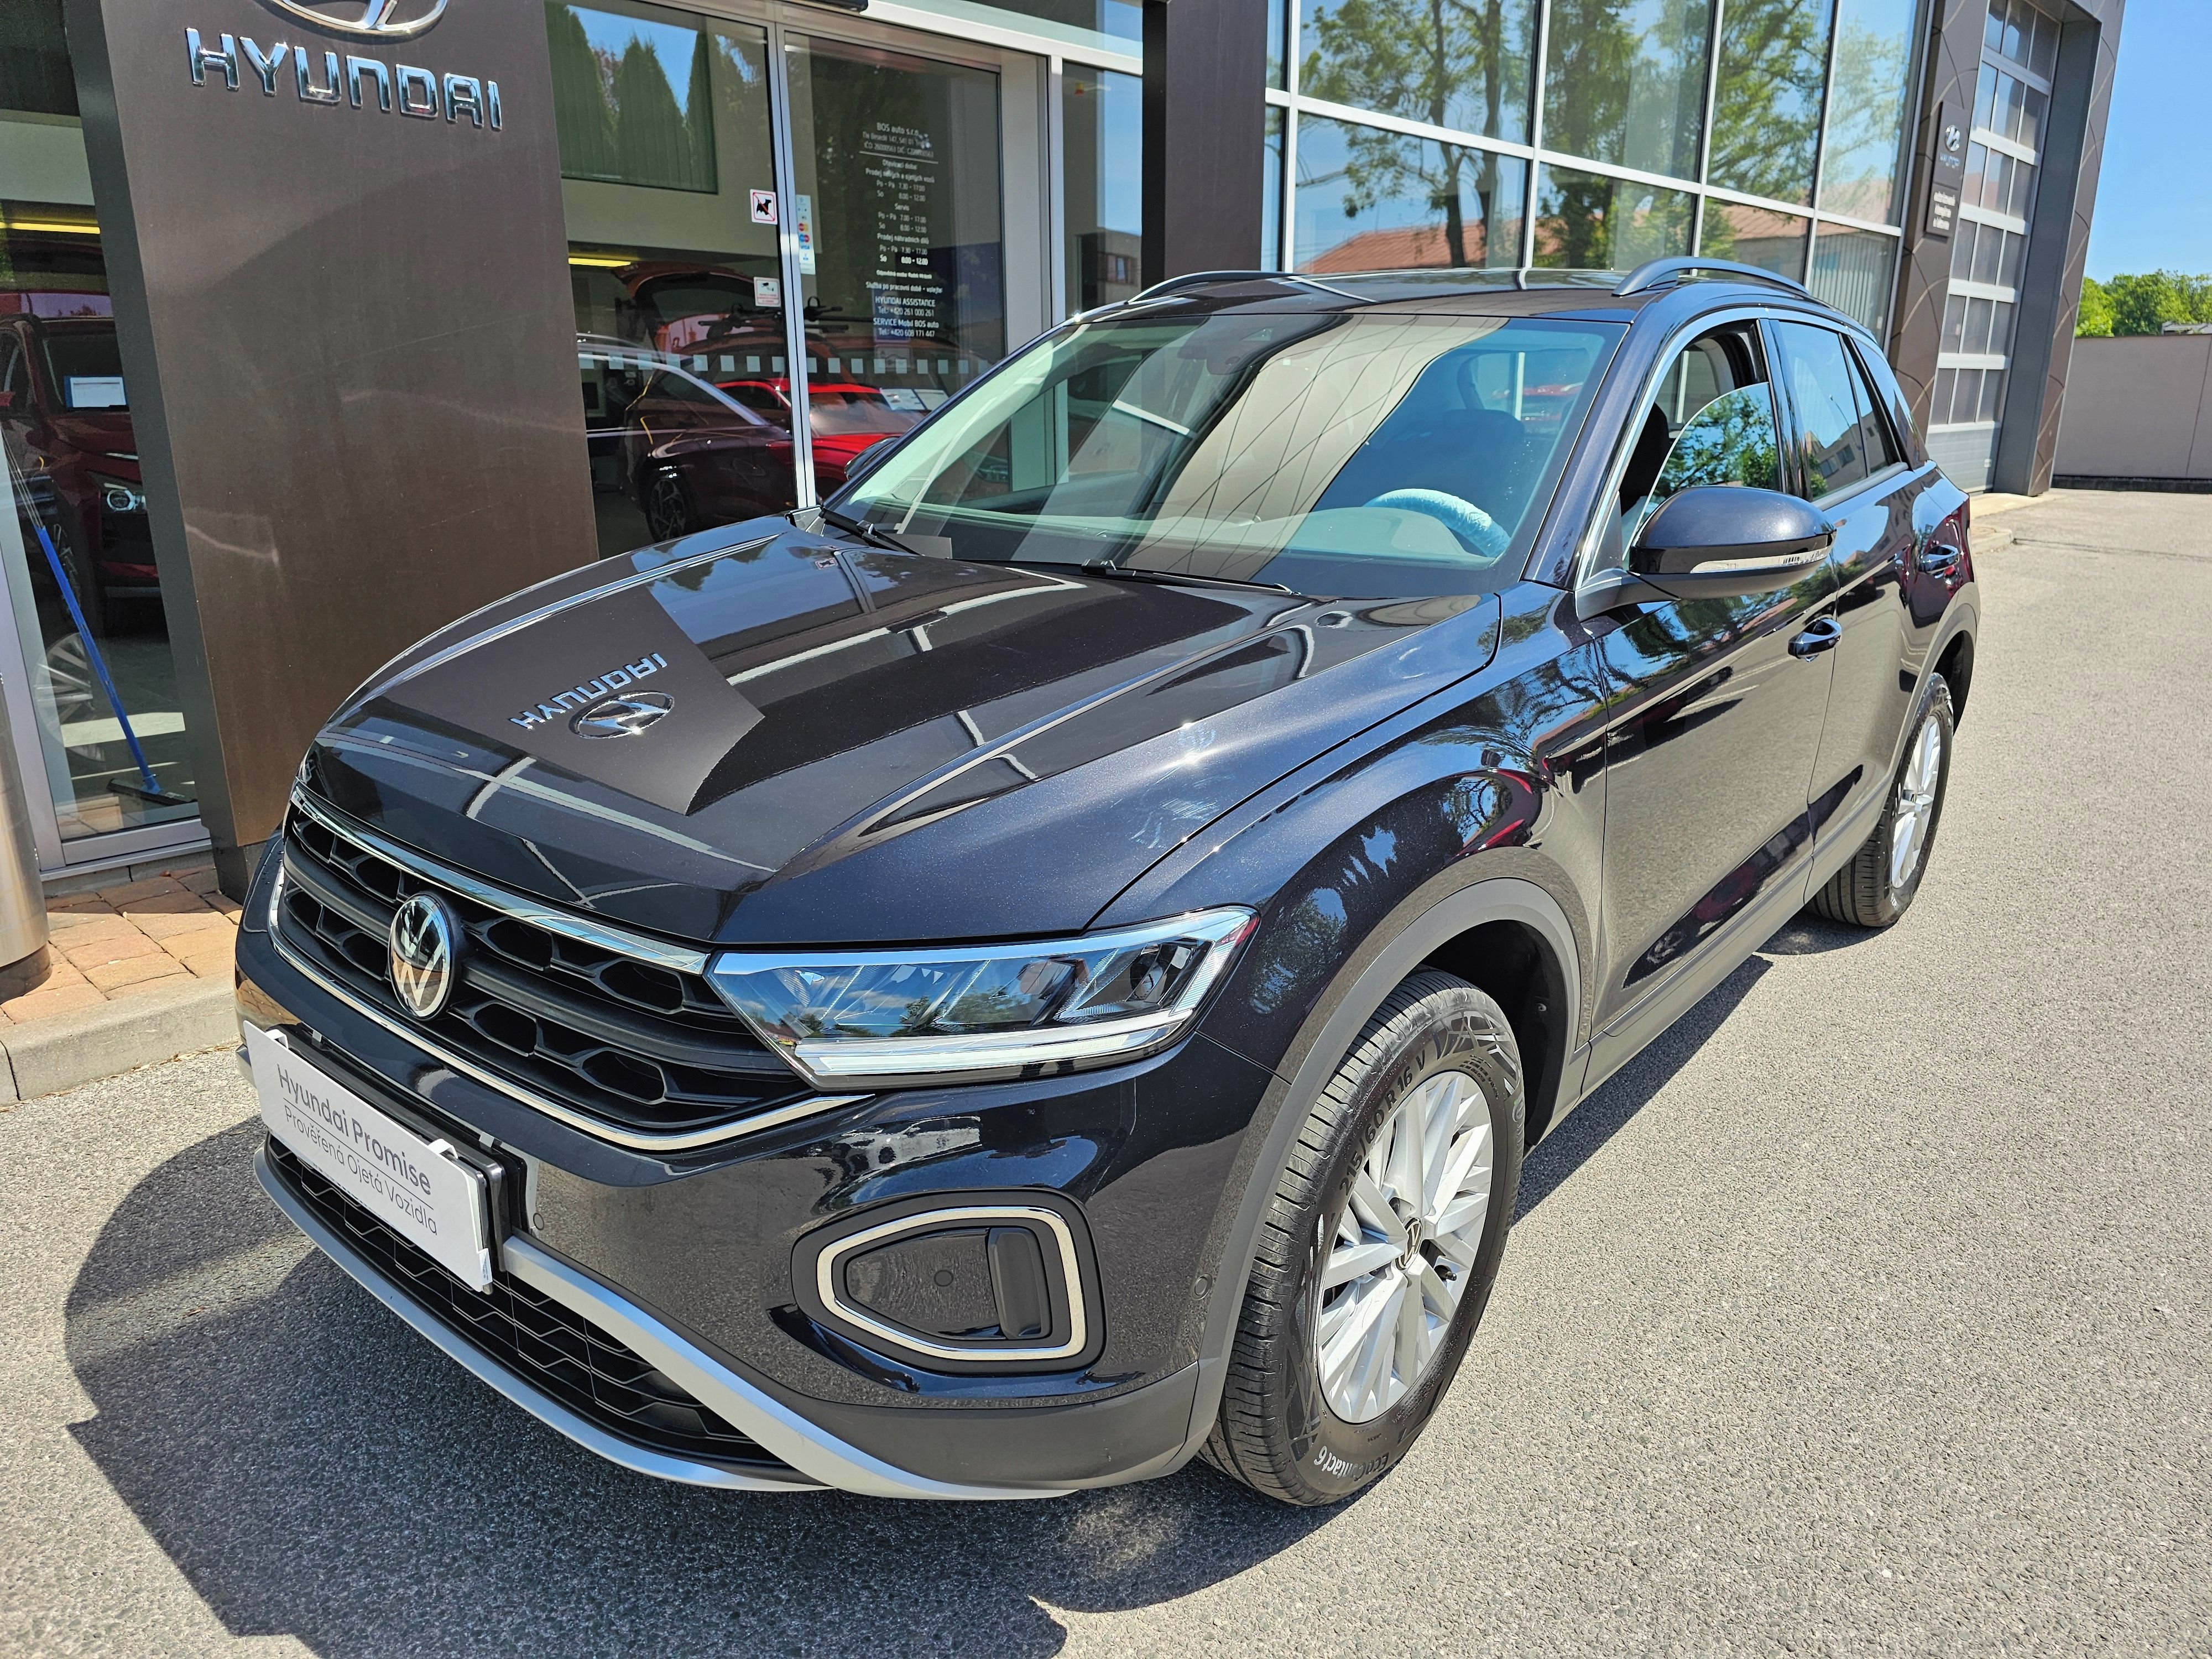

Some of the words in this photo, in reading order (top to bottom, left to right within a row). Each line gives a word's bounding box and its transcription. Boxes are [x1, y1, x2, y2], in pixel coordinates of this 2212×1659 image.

[185, 27, 503, 131] HYUNDAI
[877, 122, 890, 132] BOS
[891, 126, 905, 134] auto
[878, 211, 885, 220] Po
[879, 244, 886, 252] Po
[880, 254, 888, 262] So
[875, 296, 901, 305] HYUNDAI
[902, 298, 936, 307] ASSISTANCE
[890, 307, 903, 315] +420
[904, 307, 913, 316] 261
[914, 309, 924, 317] 000
[873, 317, 898, 326] SERVICE
[898, 319, 913, 327] Mobil
[914, 320, 926, 328] BOS
[891, 328, 904, 336] +420
[277, 1063, 348, 1137] Hyundai
[352, 1118, 431, 1195] Promise
[1339, 1112, 1384, 1196] 215/60
[284, 1105, 345, 1164] Prověřená
[347, 1154, 383, 1194] Ojetá
[384, 1185, 438, 1236] Vozidla
[1313, 1446, 1327, 1465] 6
[1321, 1452, 1389, 1481] EcoContact
